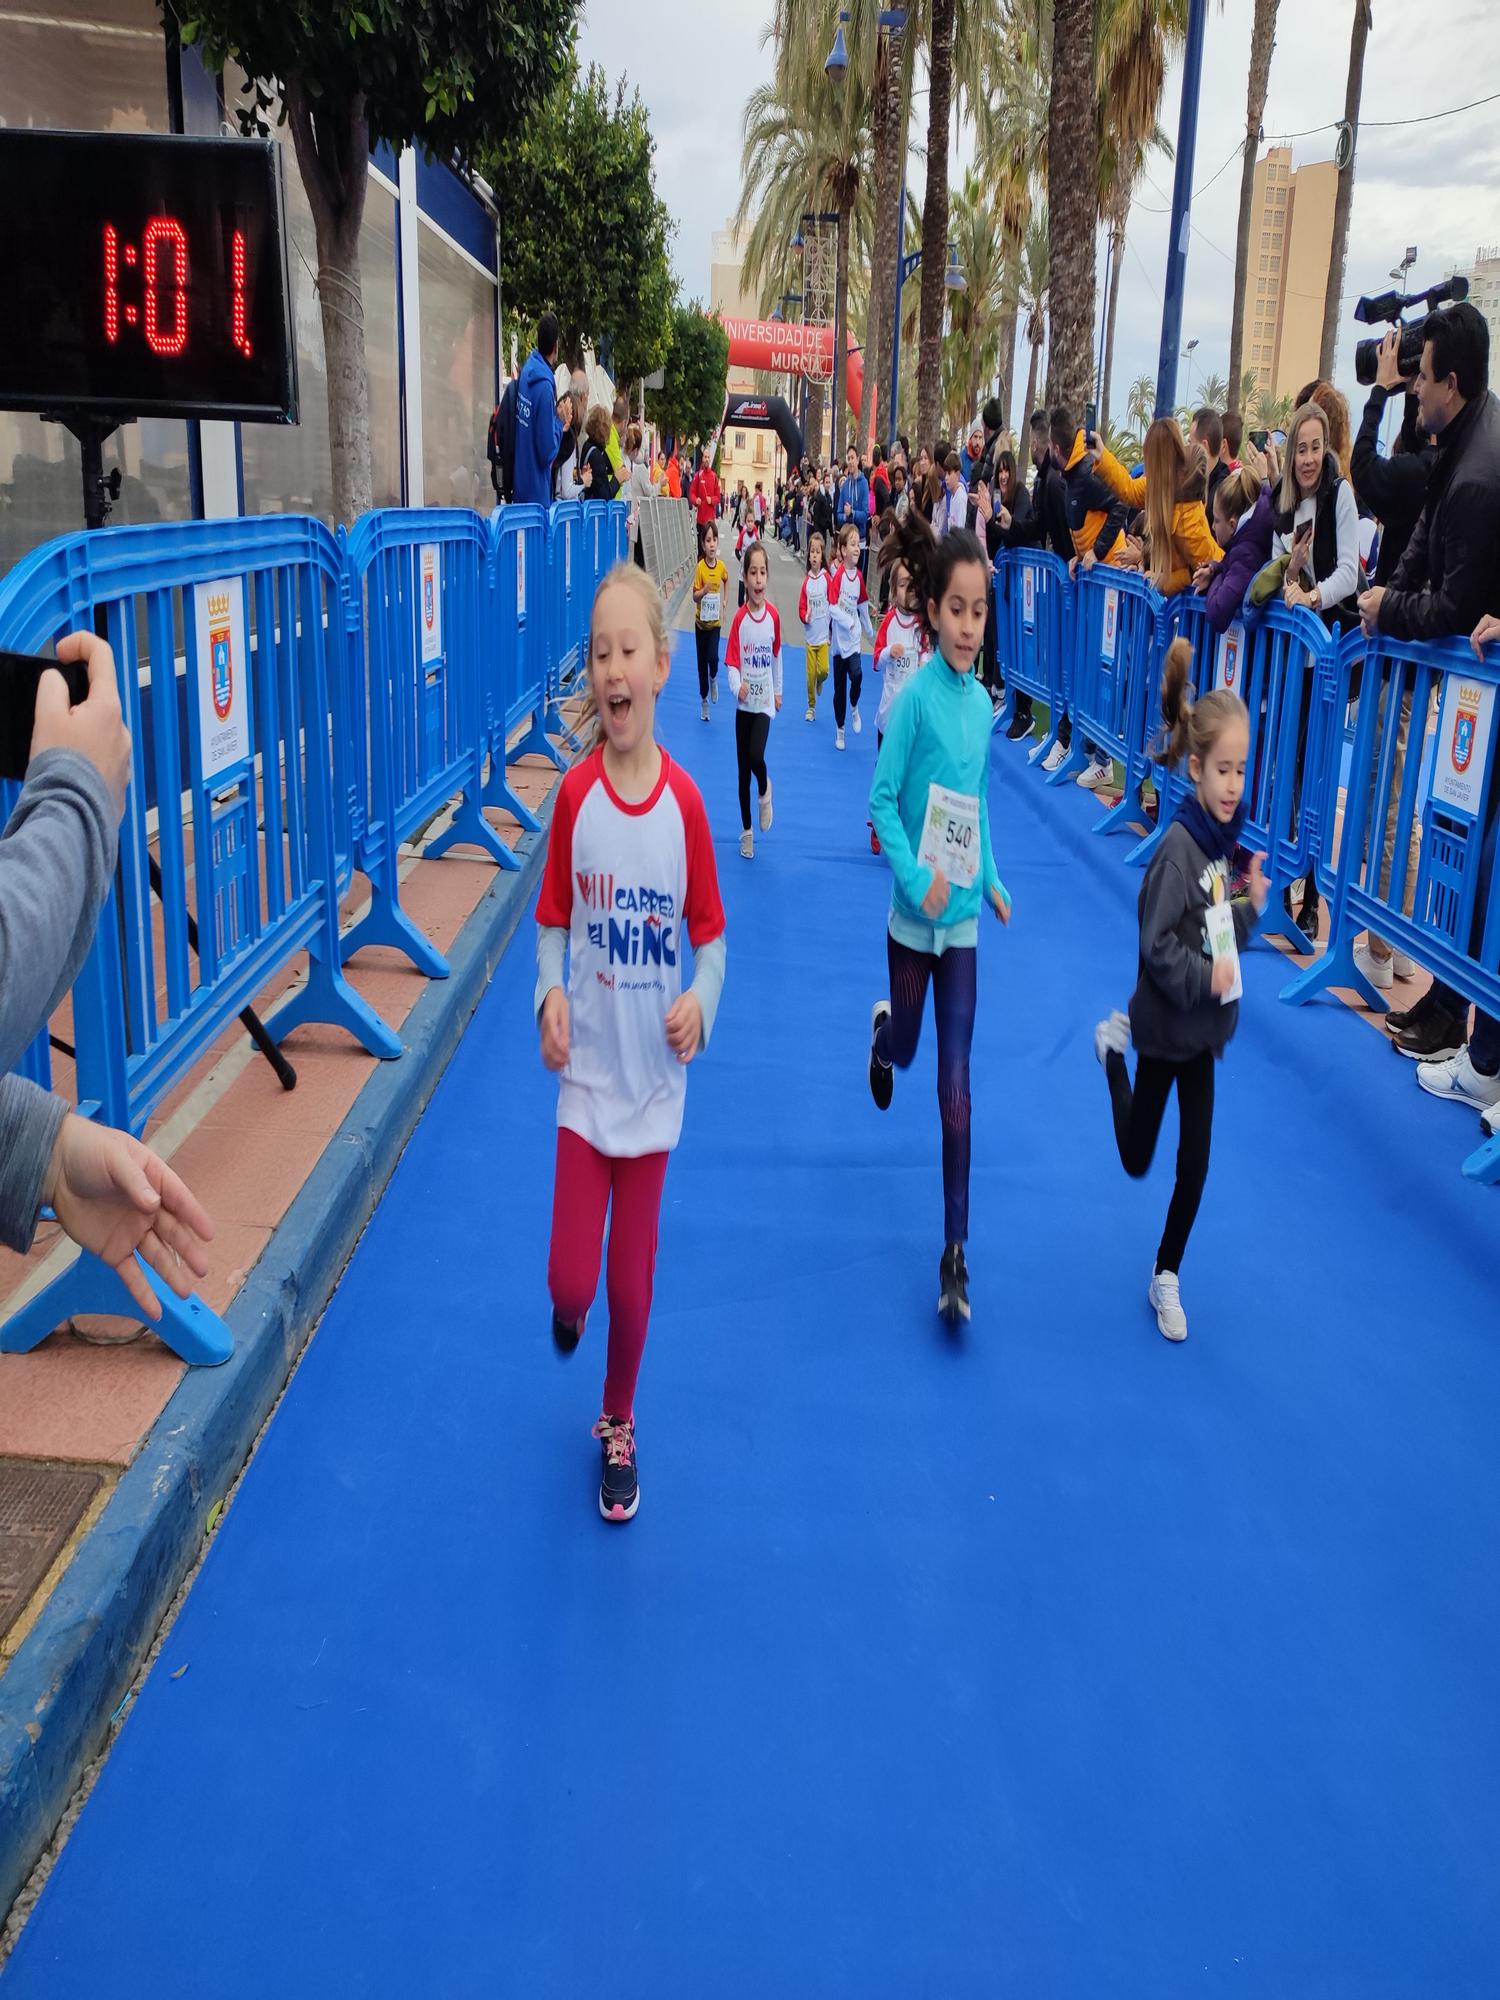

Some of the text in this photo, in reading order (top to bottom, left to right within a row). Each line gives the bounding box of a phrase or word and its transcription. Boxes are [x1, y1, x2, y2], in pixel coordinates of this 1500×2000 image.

[806, 330, 823, 349] DE
[771, 351, 822, 372] MURCIA
[896, 656, 911, 668] 530
[750, 684, 764, 696] 526
[946, 820, 972, 849] 540
